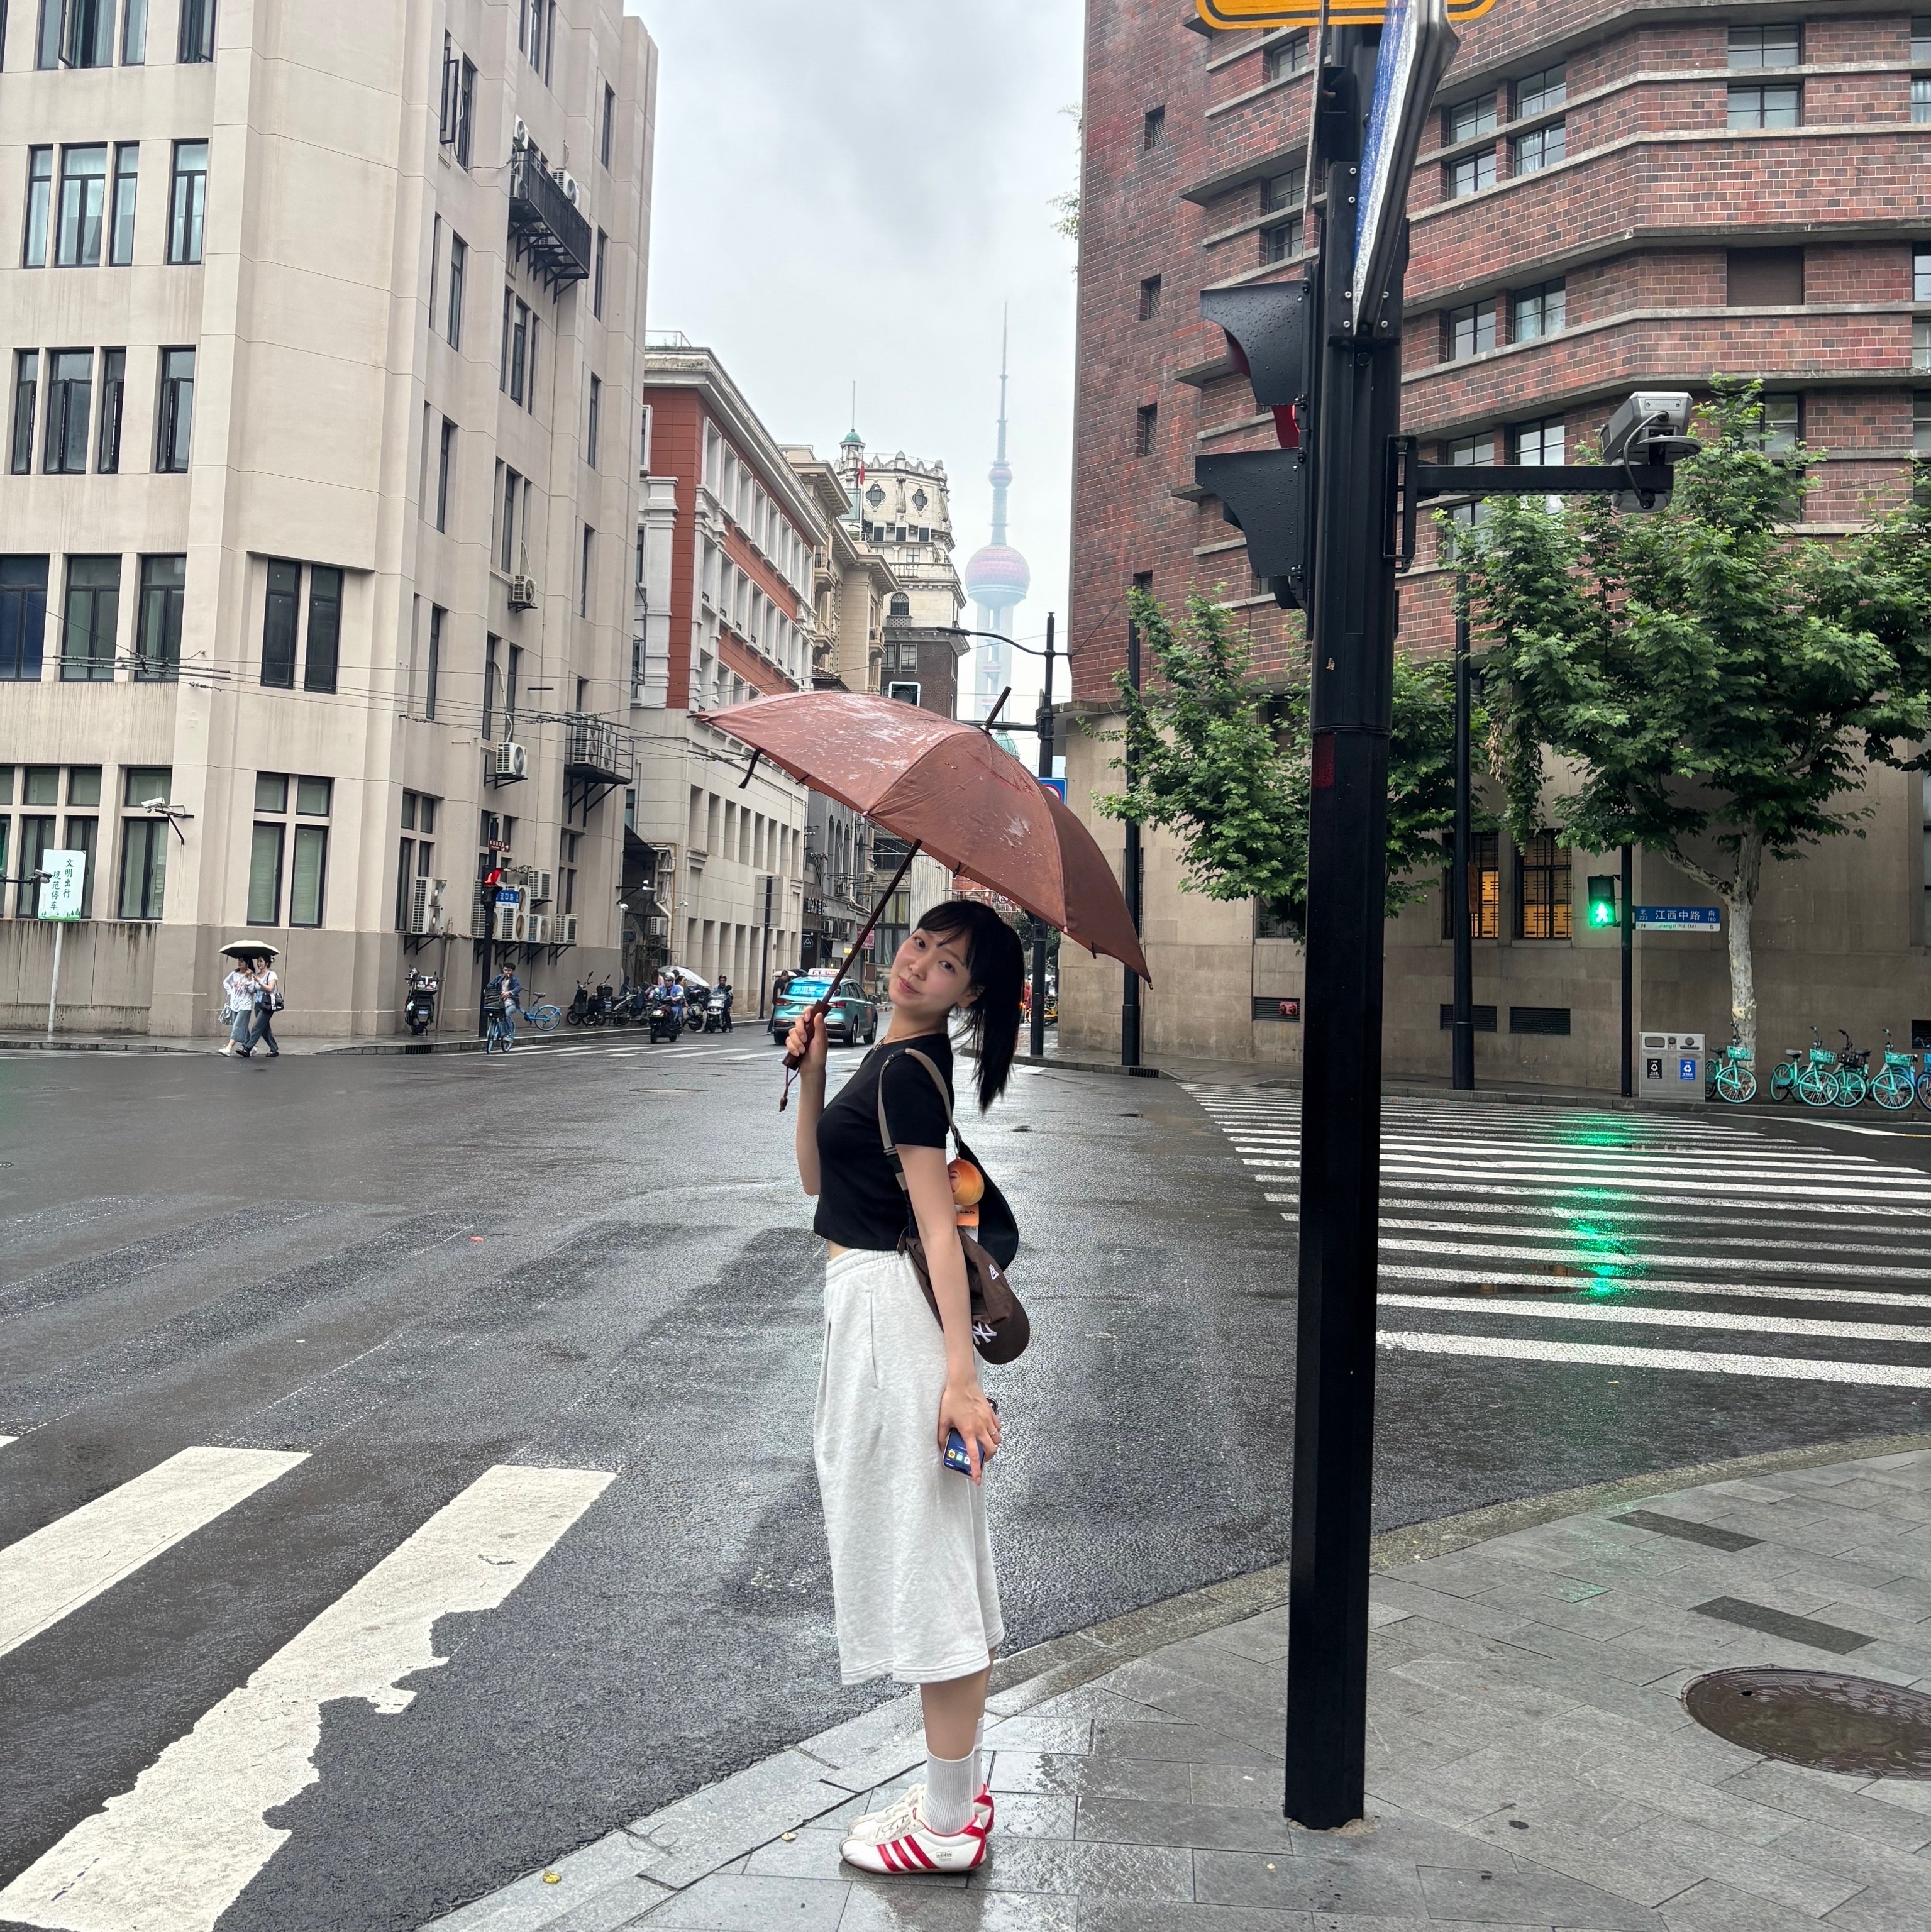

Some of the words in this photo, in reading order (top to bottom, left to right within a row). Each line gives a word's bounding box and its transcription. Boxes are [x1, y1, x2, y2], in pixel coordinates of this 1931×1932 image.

[50, 871, 61, 910] 规范停车
[64, 859, 74, 898] 文明出行
[1655, 910, 1700, 921] 江西中路
